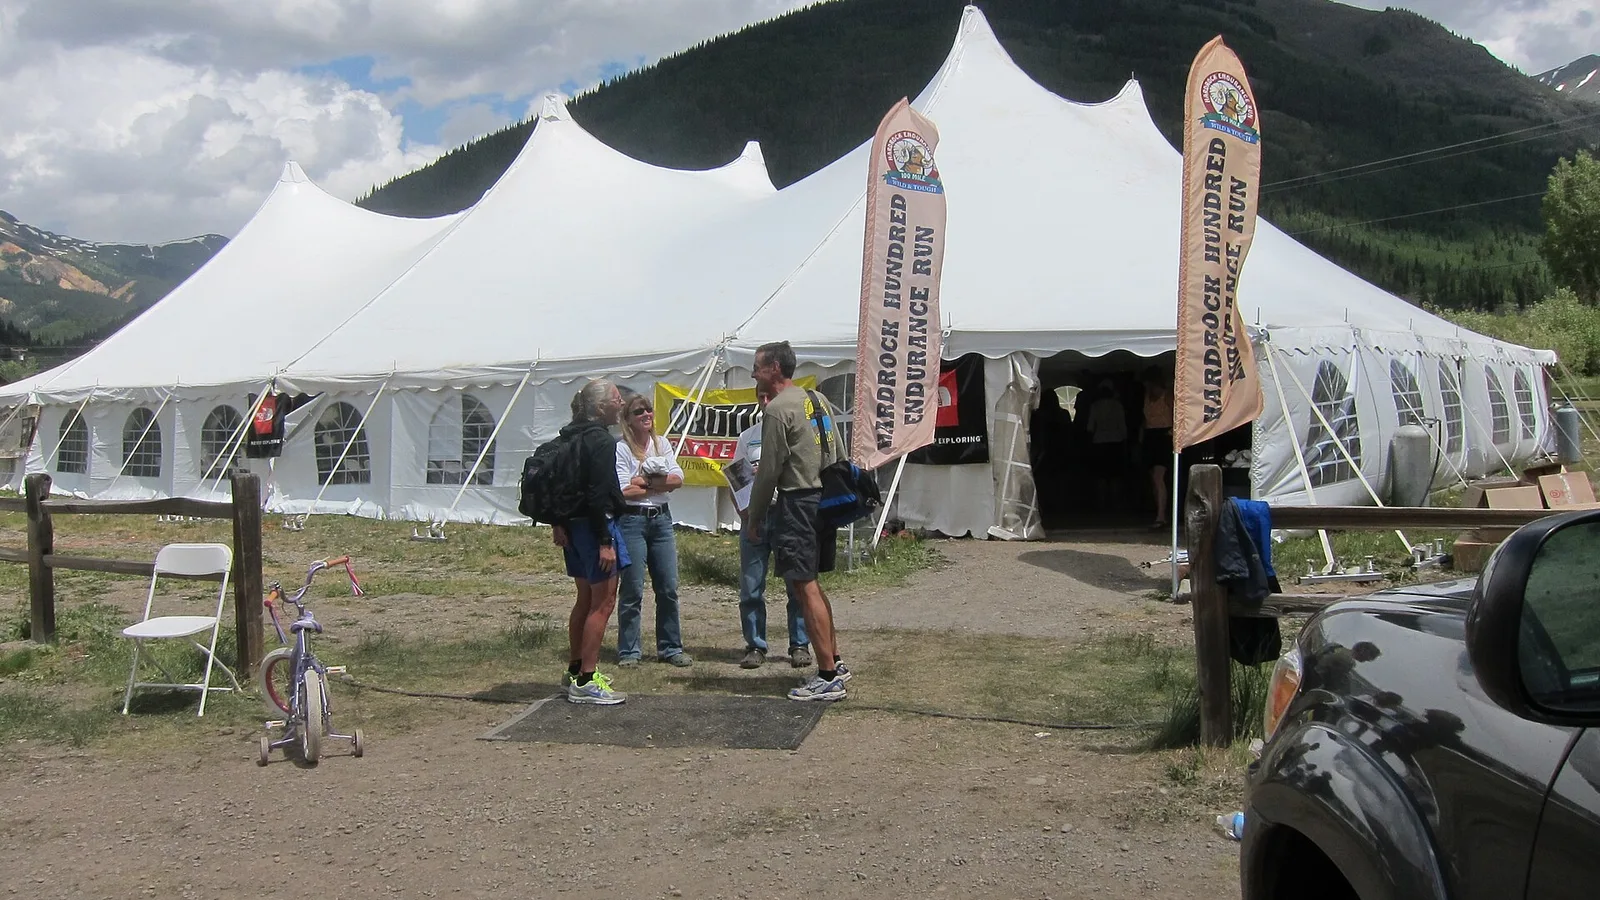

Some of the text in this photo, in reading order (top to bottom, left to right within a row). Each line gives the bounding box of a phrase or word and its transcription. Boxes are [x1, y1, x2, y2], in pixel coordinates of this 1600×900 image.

[913, 185, 937, 193] TOUGH
[1202, 136, 1227, 424] HARDROCK HUNDRED
[1226, 175, 1248, 234] RUN
[875, 193, 908, 451] HARDROCK HUNDRED
[904, 225, 935, 426] ENDURANCE RUN
